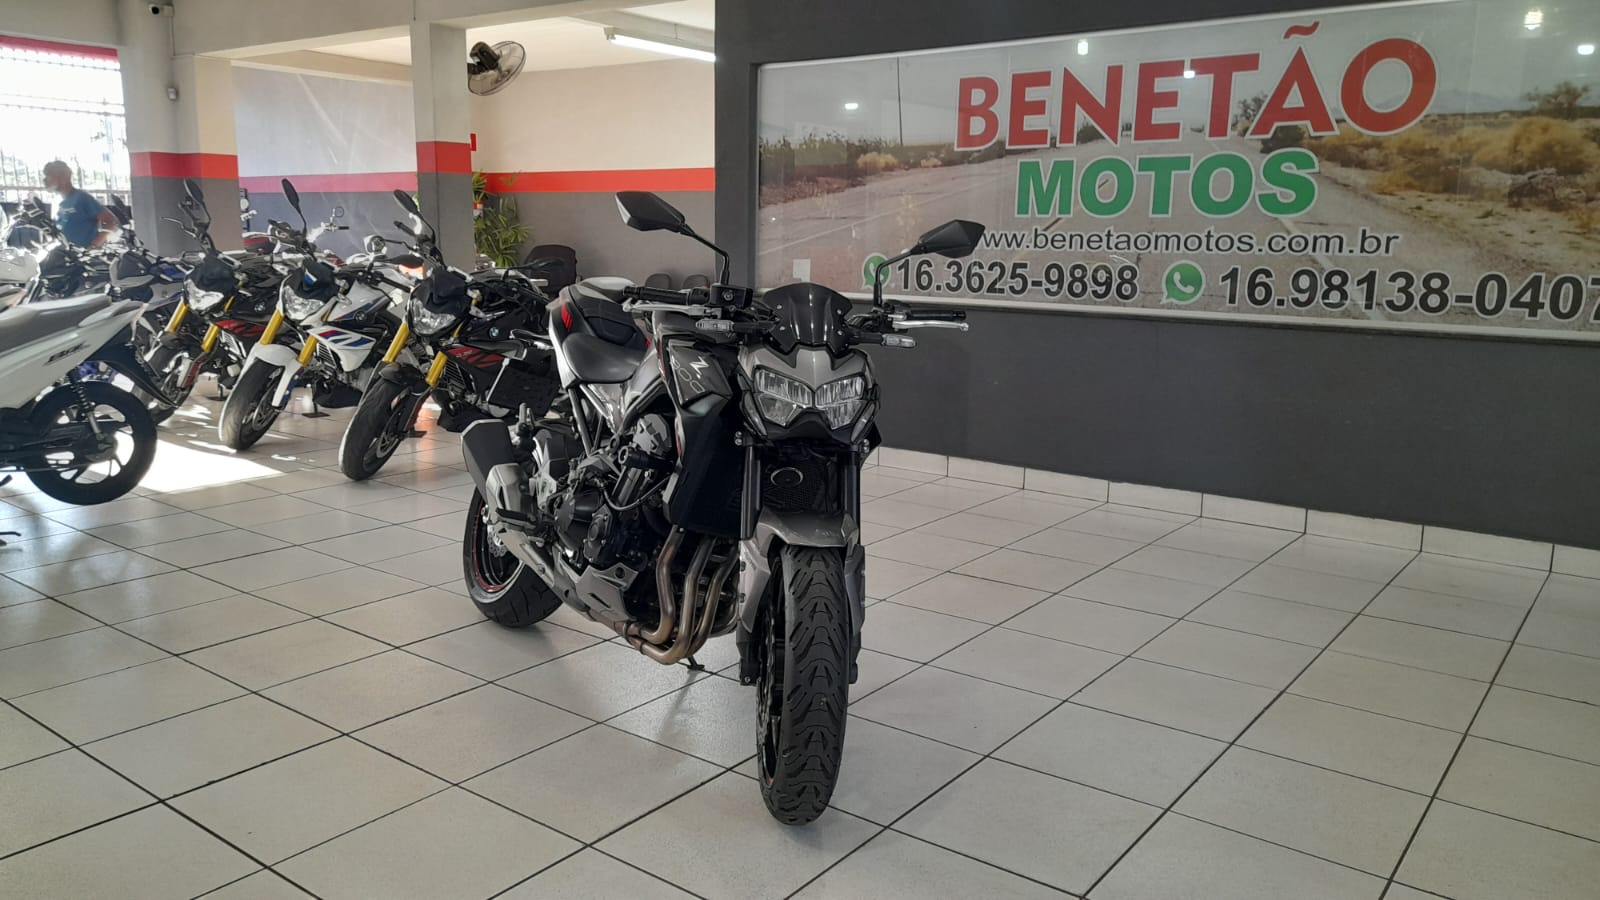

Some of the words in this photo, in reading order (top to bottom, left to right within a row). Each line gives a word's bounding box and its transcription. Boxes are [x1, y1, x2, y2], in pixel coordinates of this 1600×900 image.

[956, 21, 1437, 150] BENETÃO
[1016, 150, 1318, 216] MOTOS
[981, 227, 1399, 254] ww.benetaomotos.com.br
[898, 258, 1139, 300] 16.3625-9898
